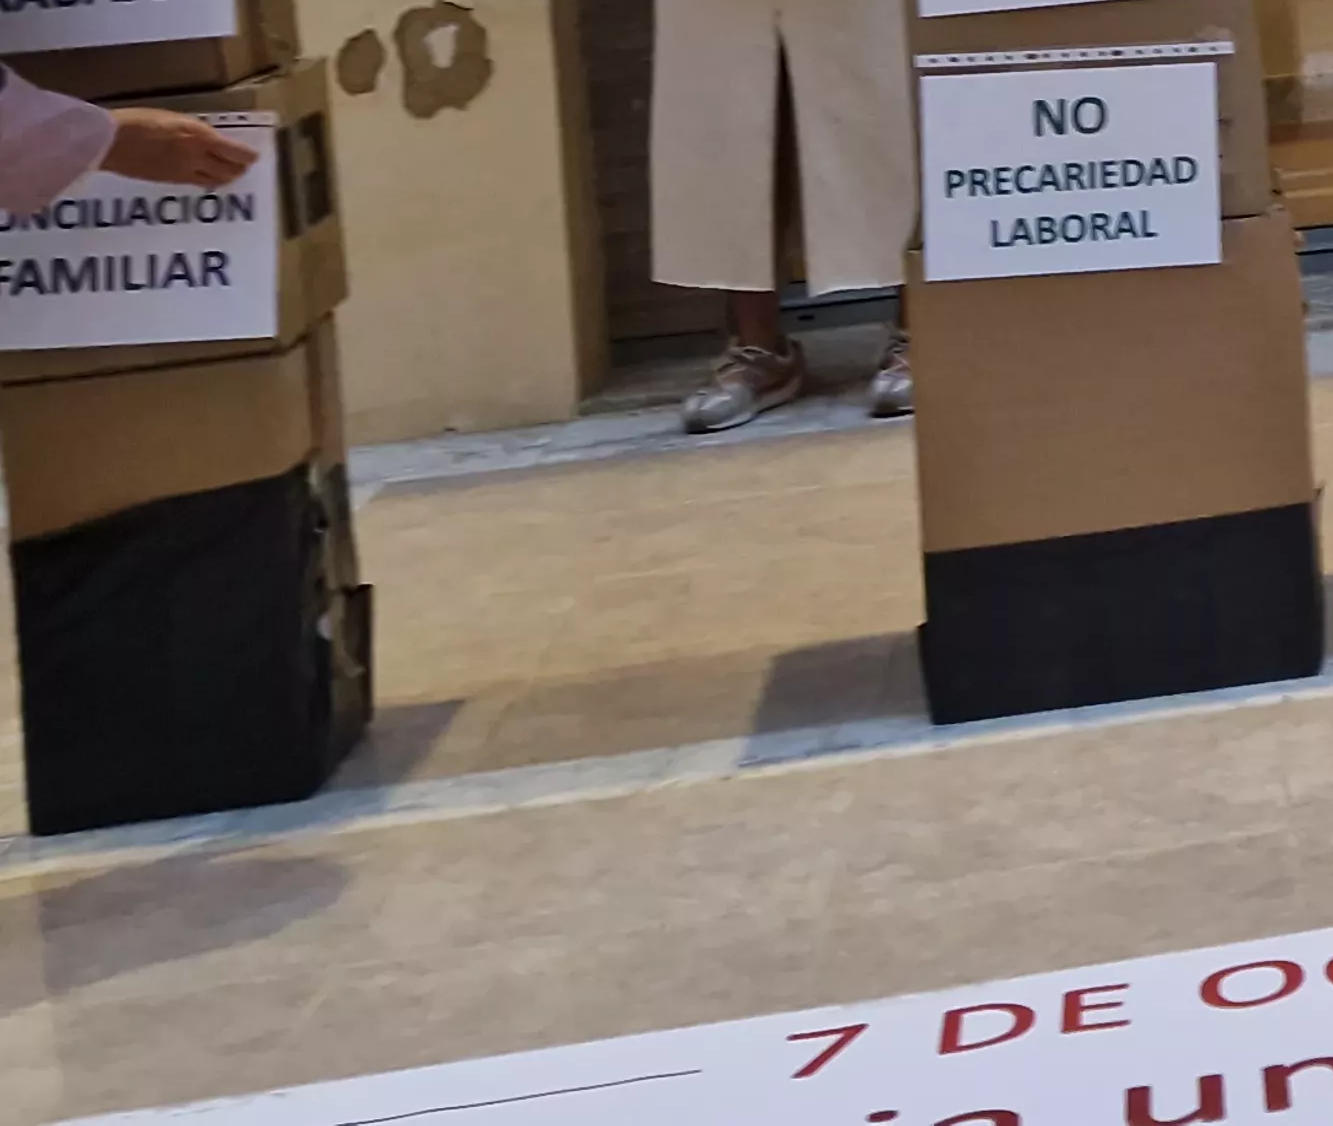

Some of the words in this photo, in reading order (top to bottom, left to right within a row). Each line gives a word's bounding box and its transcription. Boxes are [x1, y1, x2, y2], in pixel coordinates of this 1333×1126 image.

[1032, 96, 1109, 137] NO
[944, 156, 1198, 199] PRECARIEDAD
[990, 210, 1160, 248] LABORAL
[786, 1022, 869, 1081] 7
[937, 982, 1132, 1056] DE
